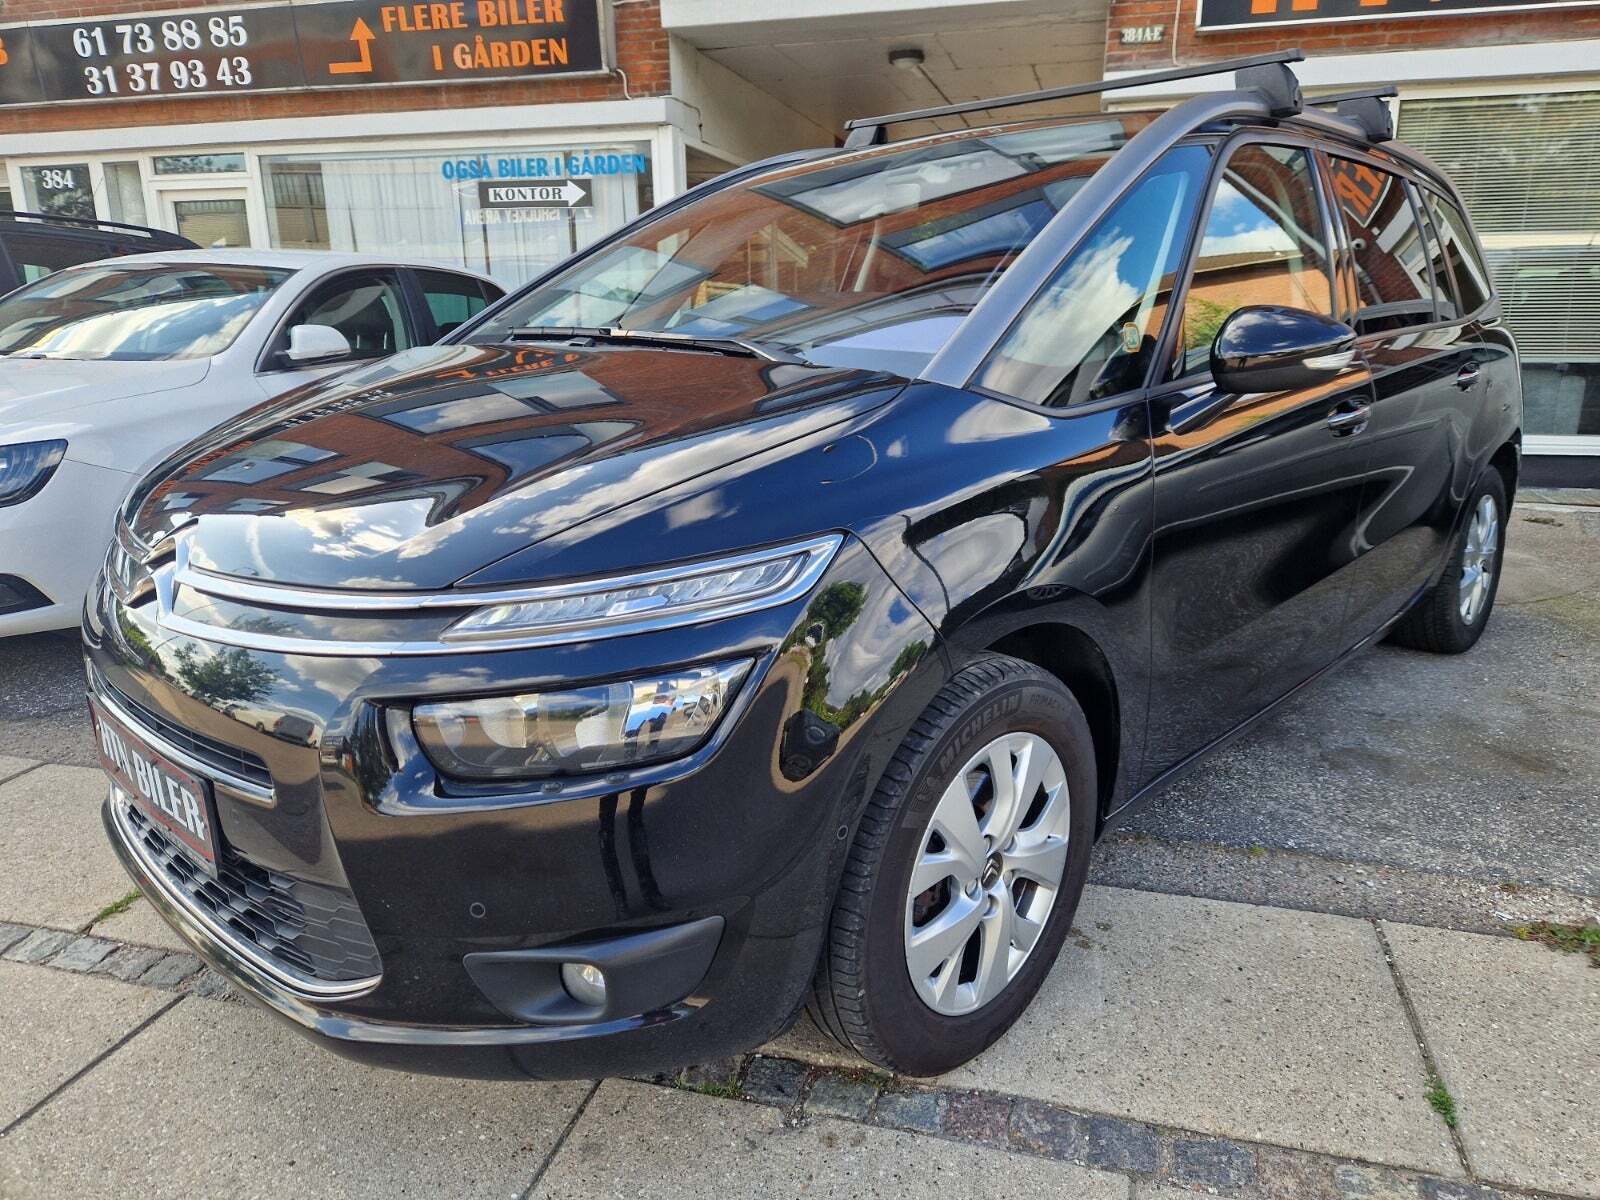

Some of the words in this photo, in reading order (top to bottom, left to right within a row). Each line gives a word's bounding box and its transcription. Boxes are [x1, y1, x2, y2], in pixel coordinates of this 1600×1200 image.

[381, 2, 468, 33] FLERE
[477, 0, 565, 28] BILER
[72, 27, 107, 58] 61
[115, 23, 155, 54] 73
[161, 19, 201, 51] 88
[208, 15, 248, 48] 85
[432, 44, 443, 71] I
[453, 34, 569, 70] GÅRDEN
[84, 66, 118, 95] 31
[126, 62, 160, 92] 37
[169, 59, 207, 89] 93
[216, 56, 251, 86] 43
[41, 169, 74, 189] 384
[442, 153, 490, 180] OGSÅ
[499, 157, 549, 178] BILER
[555, 157, 561, 176] I
[566, 150, 647, 177] GÅRDEN
[493, 188, 562, 202] KONTOR
[939, 694, 1021, 775] MICHELIN
[132, 750, 206, 841] BILER
